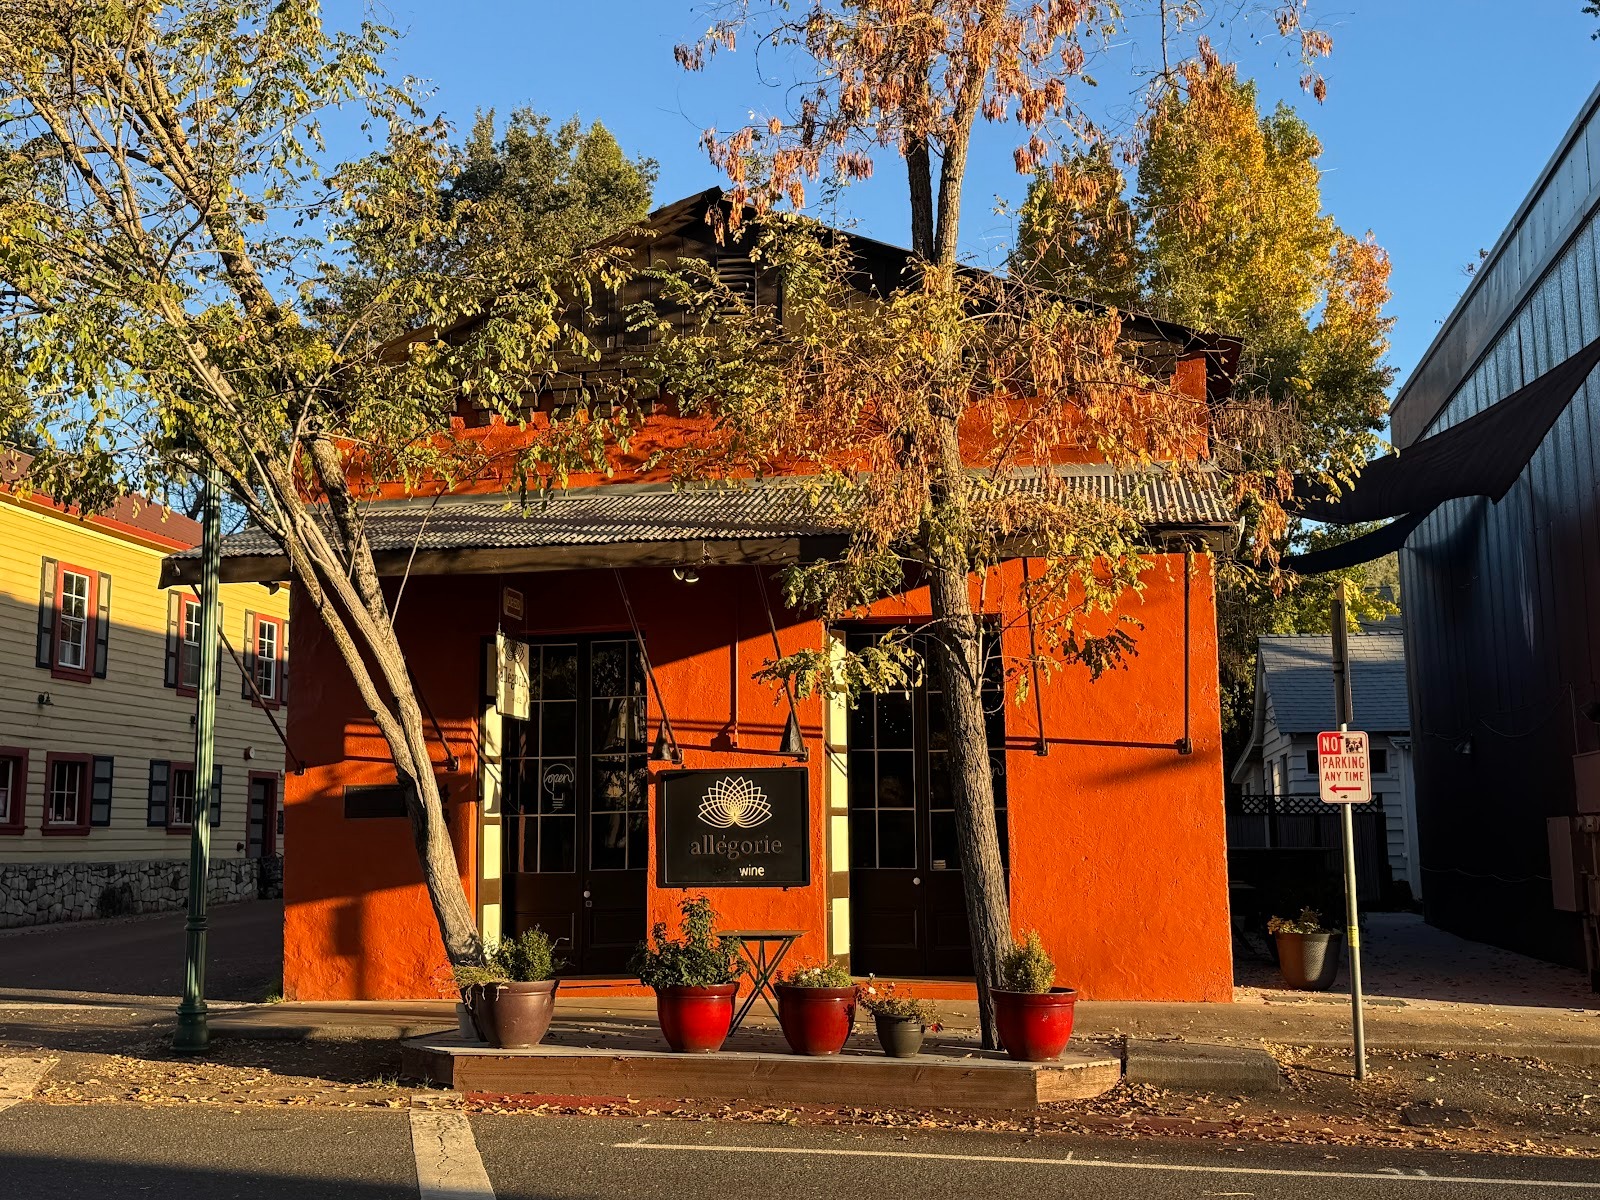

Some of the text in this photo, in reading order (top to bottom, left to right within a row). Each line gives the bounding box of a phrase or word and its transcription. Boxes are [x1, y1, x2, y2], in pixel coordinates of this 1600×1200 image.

[1322, 736, 1338, 752] NO
[1322, 756, 1365, 769] PARKING
[544, 773, 573, 792] open
[1324, 771, 1365, 782] ANY TIME
[690, 834, 782, 860] allégorie
[738, 864, 765, 877] wine
